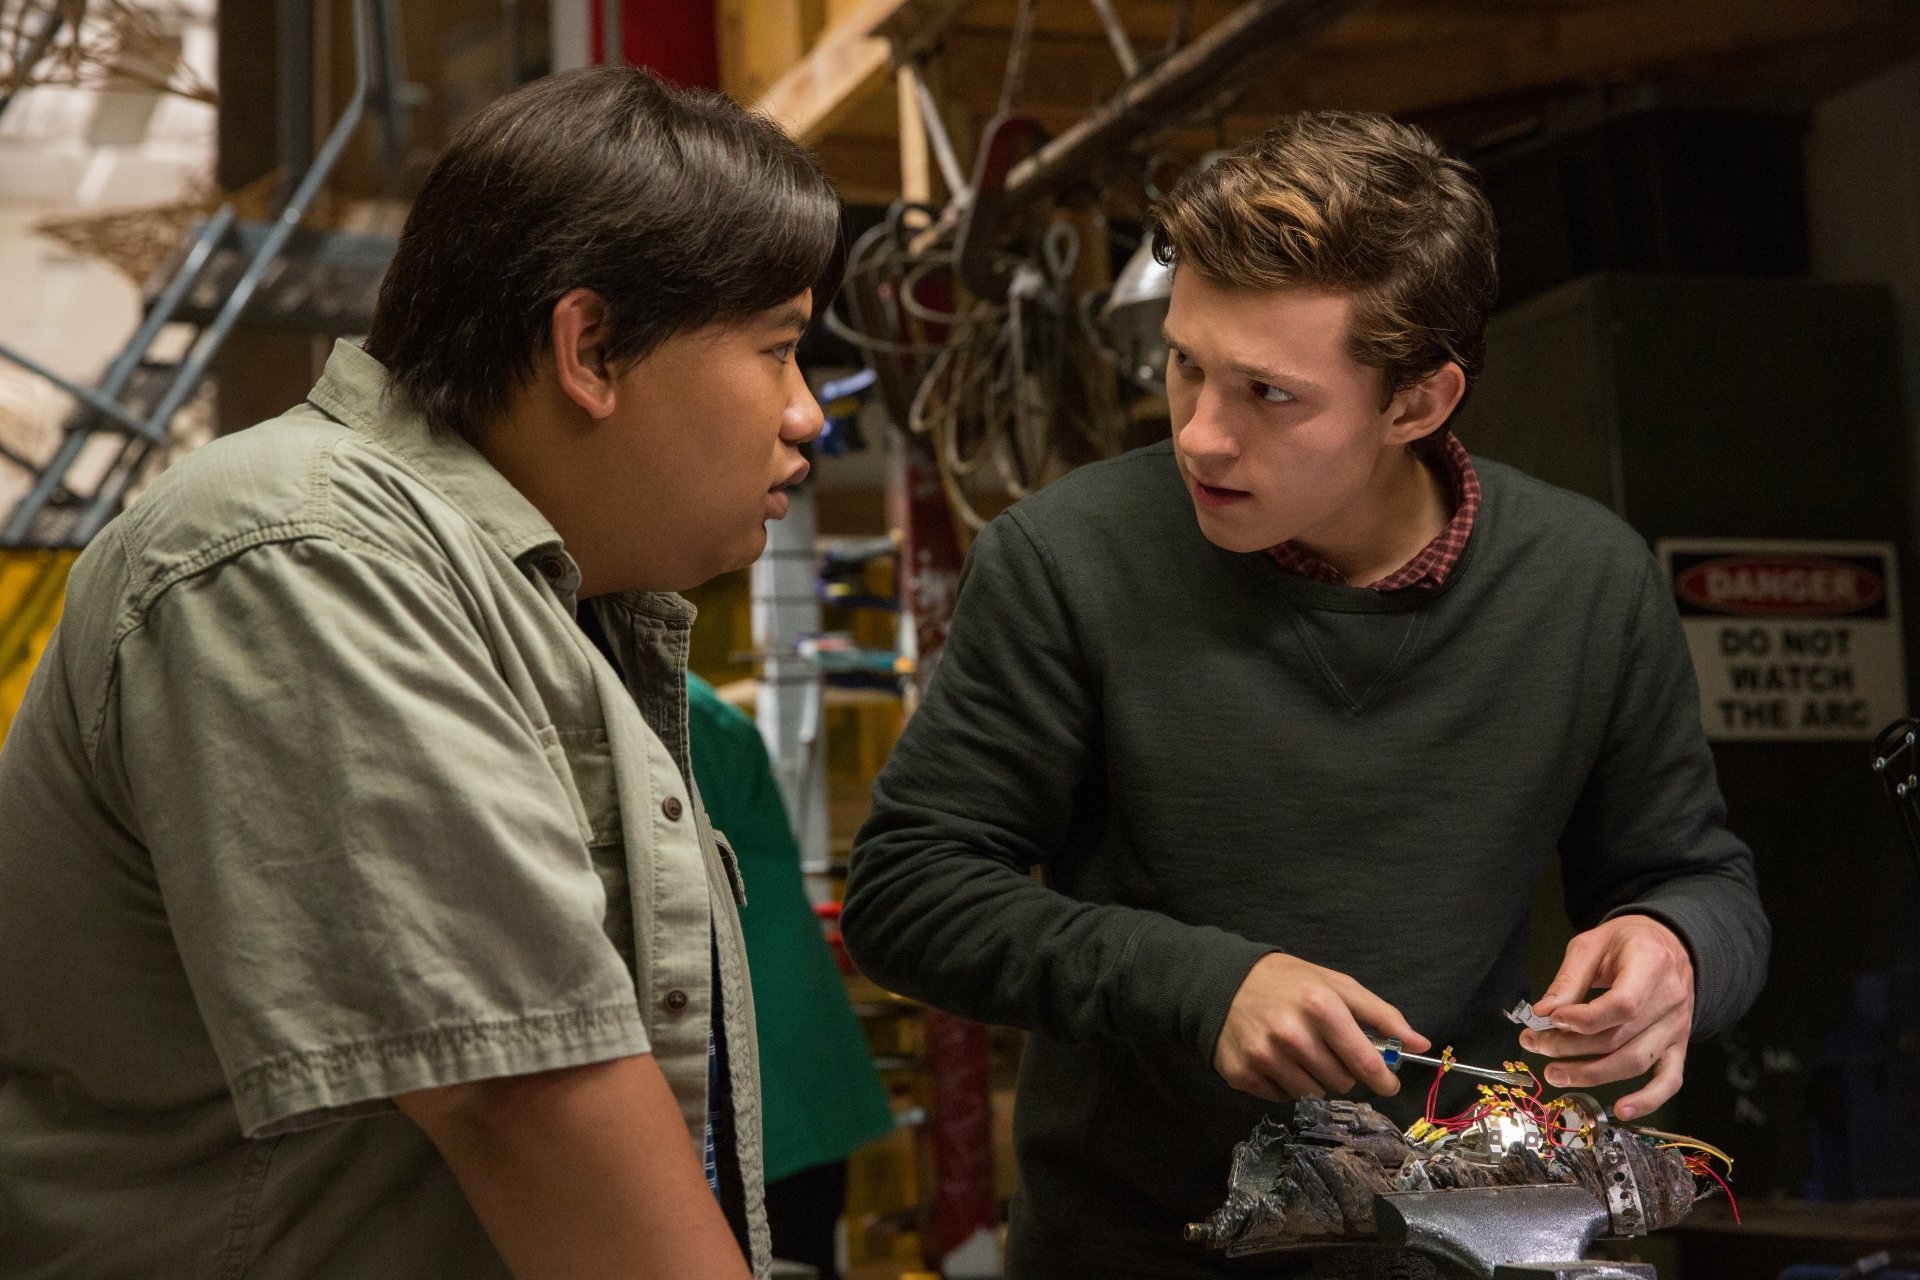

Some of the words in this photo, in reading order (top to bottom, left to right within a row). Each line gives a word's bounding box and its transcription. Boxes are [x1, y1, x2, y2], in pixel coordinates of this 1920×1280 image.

[1704, 567, 1858, 601] DANGER
[1719, 628, 1769, 655] DO
[1782, 628, 1849, 655] NOT
[1730, 665, 1854, 692] WATCH
[1717, 699, 1785, 728] THE
[1801, 700, 1868, 727] ARC
